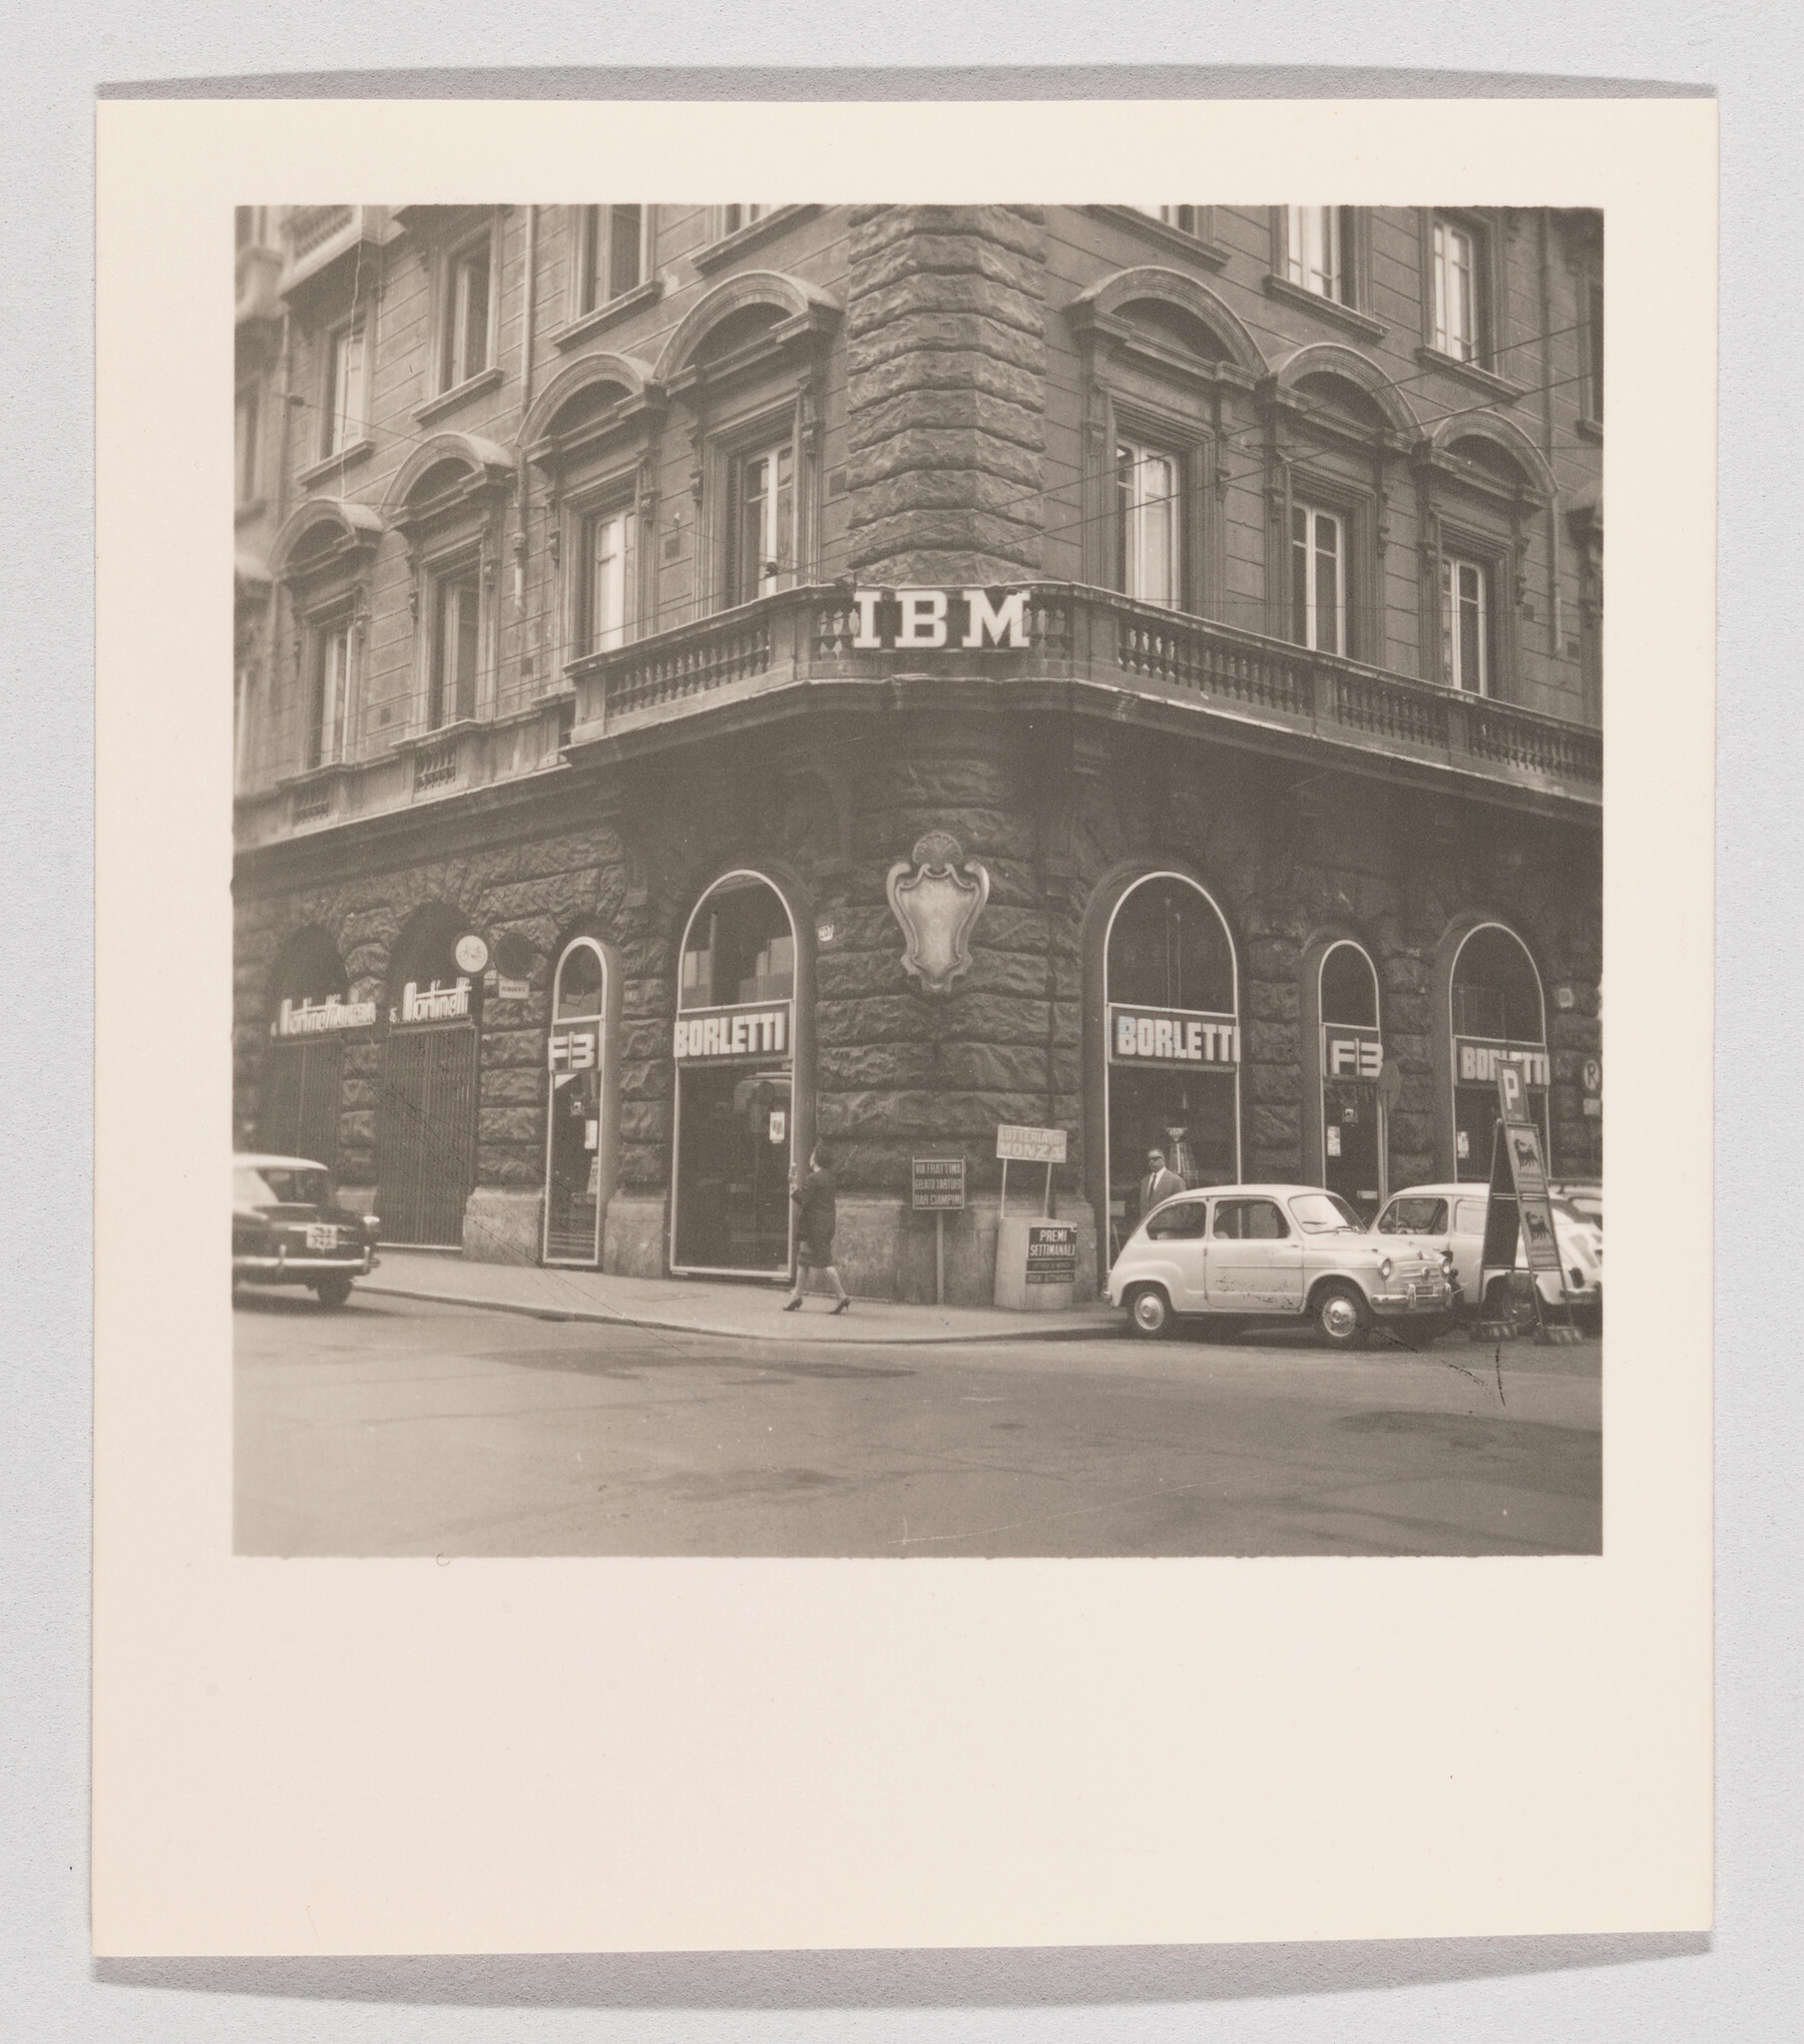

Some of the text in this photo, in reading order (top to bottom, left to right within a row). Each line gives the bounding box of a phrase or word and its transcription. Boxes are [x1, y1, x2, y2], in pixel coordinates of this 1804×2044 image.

[853, 590, 1031, 648] IBM
[674, 1012, 785, 1058] BORLETTI
[1118, 1016, 1240, 1062] BORLETTI
[1461, 1047, 1551, 1085] BORTTI
[1503, 1069, 1520, 1110] P
[927, 1164, 961, 1175] FRATTINA
[915, 1195, 929, 1205] BAR
[1030, 1244, 1076, 1257] SETTIMANALI
[1040, 1230, 1067, 1242] PREMI
